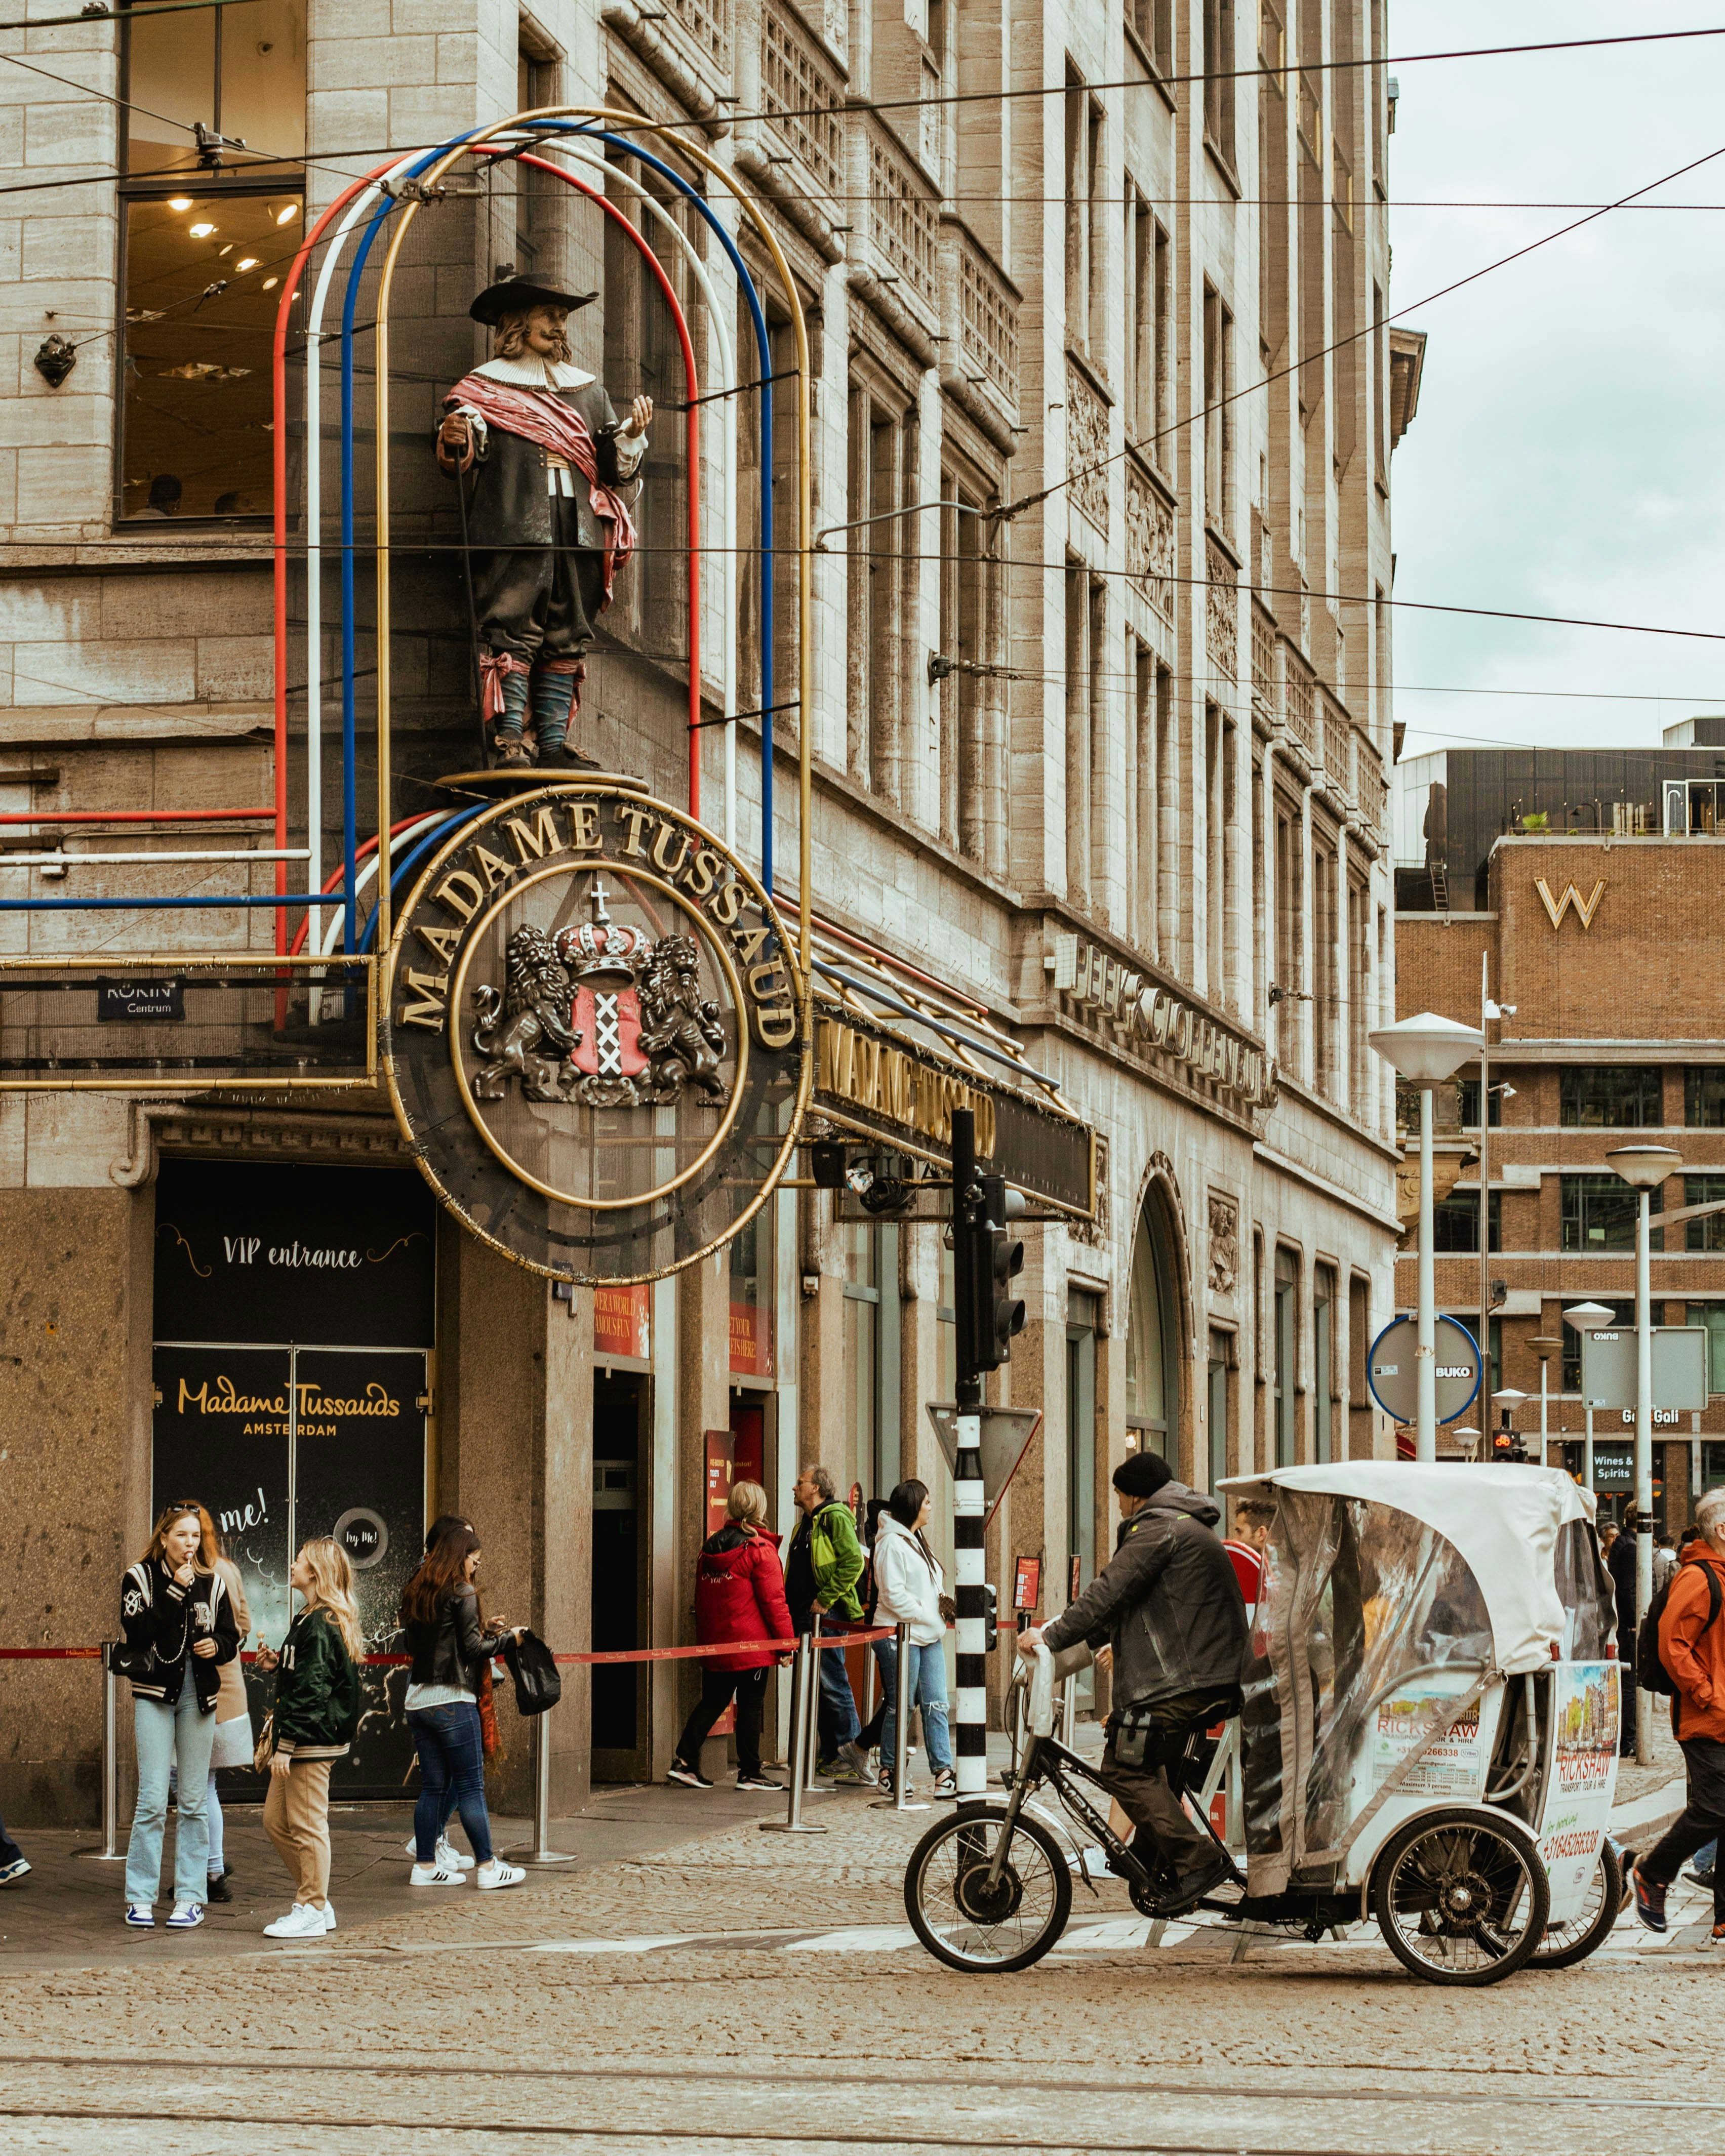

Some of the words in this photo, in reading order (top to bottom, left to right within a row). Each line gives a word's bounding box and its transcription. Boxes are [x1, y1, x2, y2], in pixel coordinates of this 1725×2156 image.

[1534, 877, 1609, 930] W
[403, 803, 604, 1034] MADAME
[619, 805, 796, 1049] TUSSAUD
[127, 1003, 171, 1013] Centrum
[1063, 934, 1128, 1022] PEEK
[1143, 988, 1279, 1109] CLOPPENBURG
[224, 1236, 261, 1265] VIP
[268, 1240, 363, 1268] entrance
[178, 1375, 292, 1414] Madame
[284, 1382, 400, 1417] Tussauds
[244, 1423, 337, 1436] AMSTERDAM
[1594, 1456, 1624, 1466] Wines
[1625, 1457, 1633, 1466] &
[1598, 1469, 1630, 1480] Spirits
[220, 1487, 269, 1533] me!
[346, 1531, 359, 1547] Try
[362, 1531, 377, 1543] Me!
[1377, 1719, 1479, 1738] RICKSAW
[1559, 1750, 1612, 1782] RICKSHAW
[1543, 1829, 1599, 1861] +31645266338
